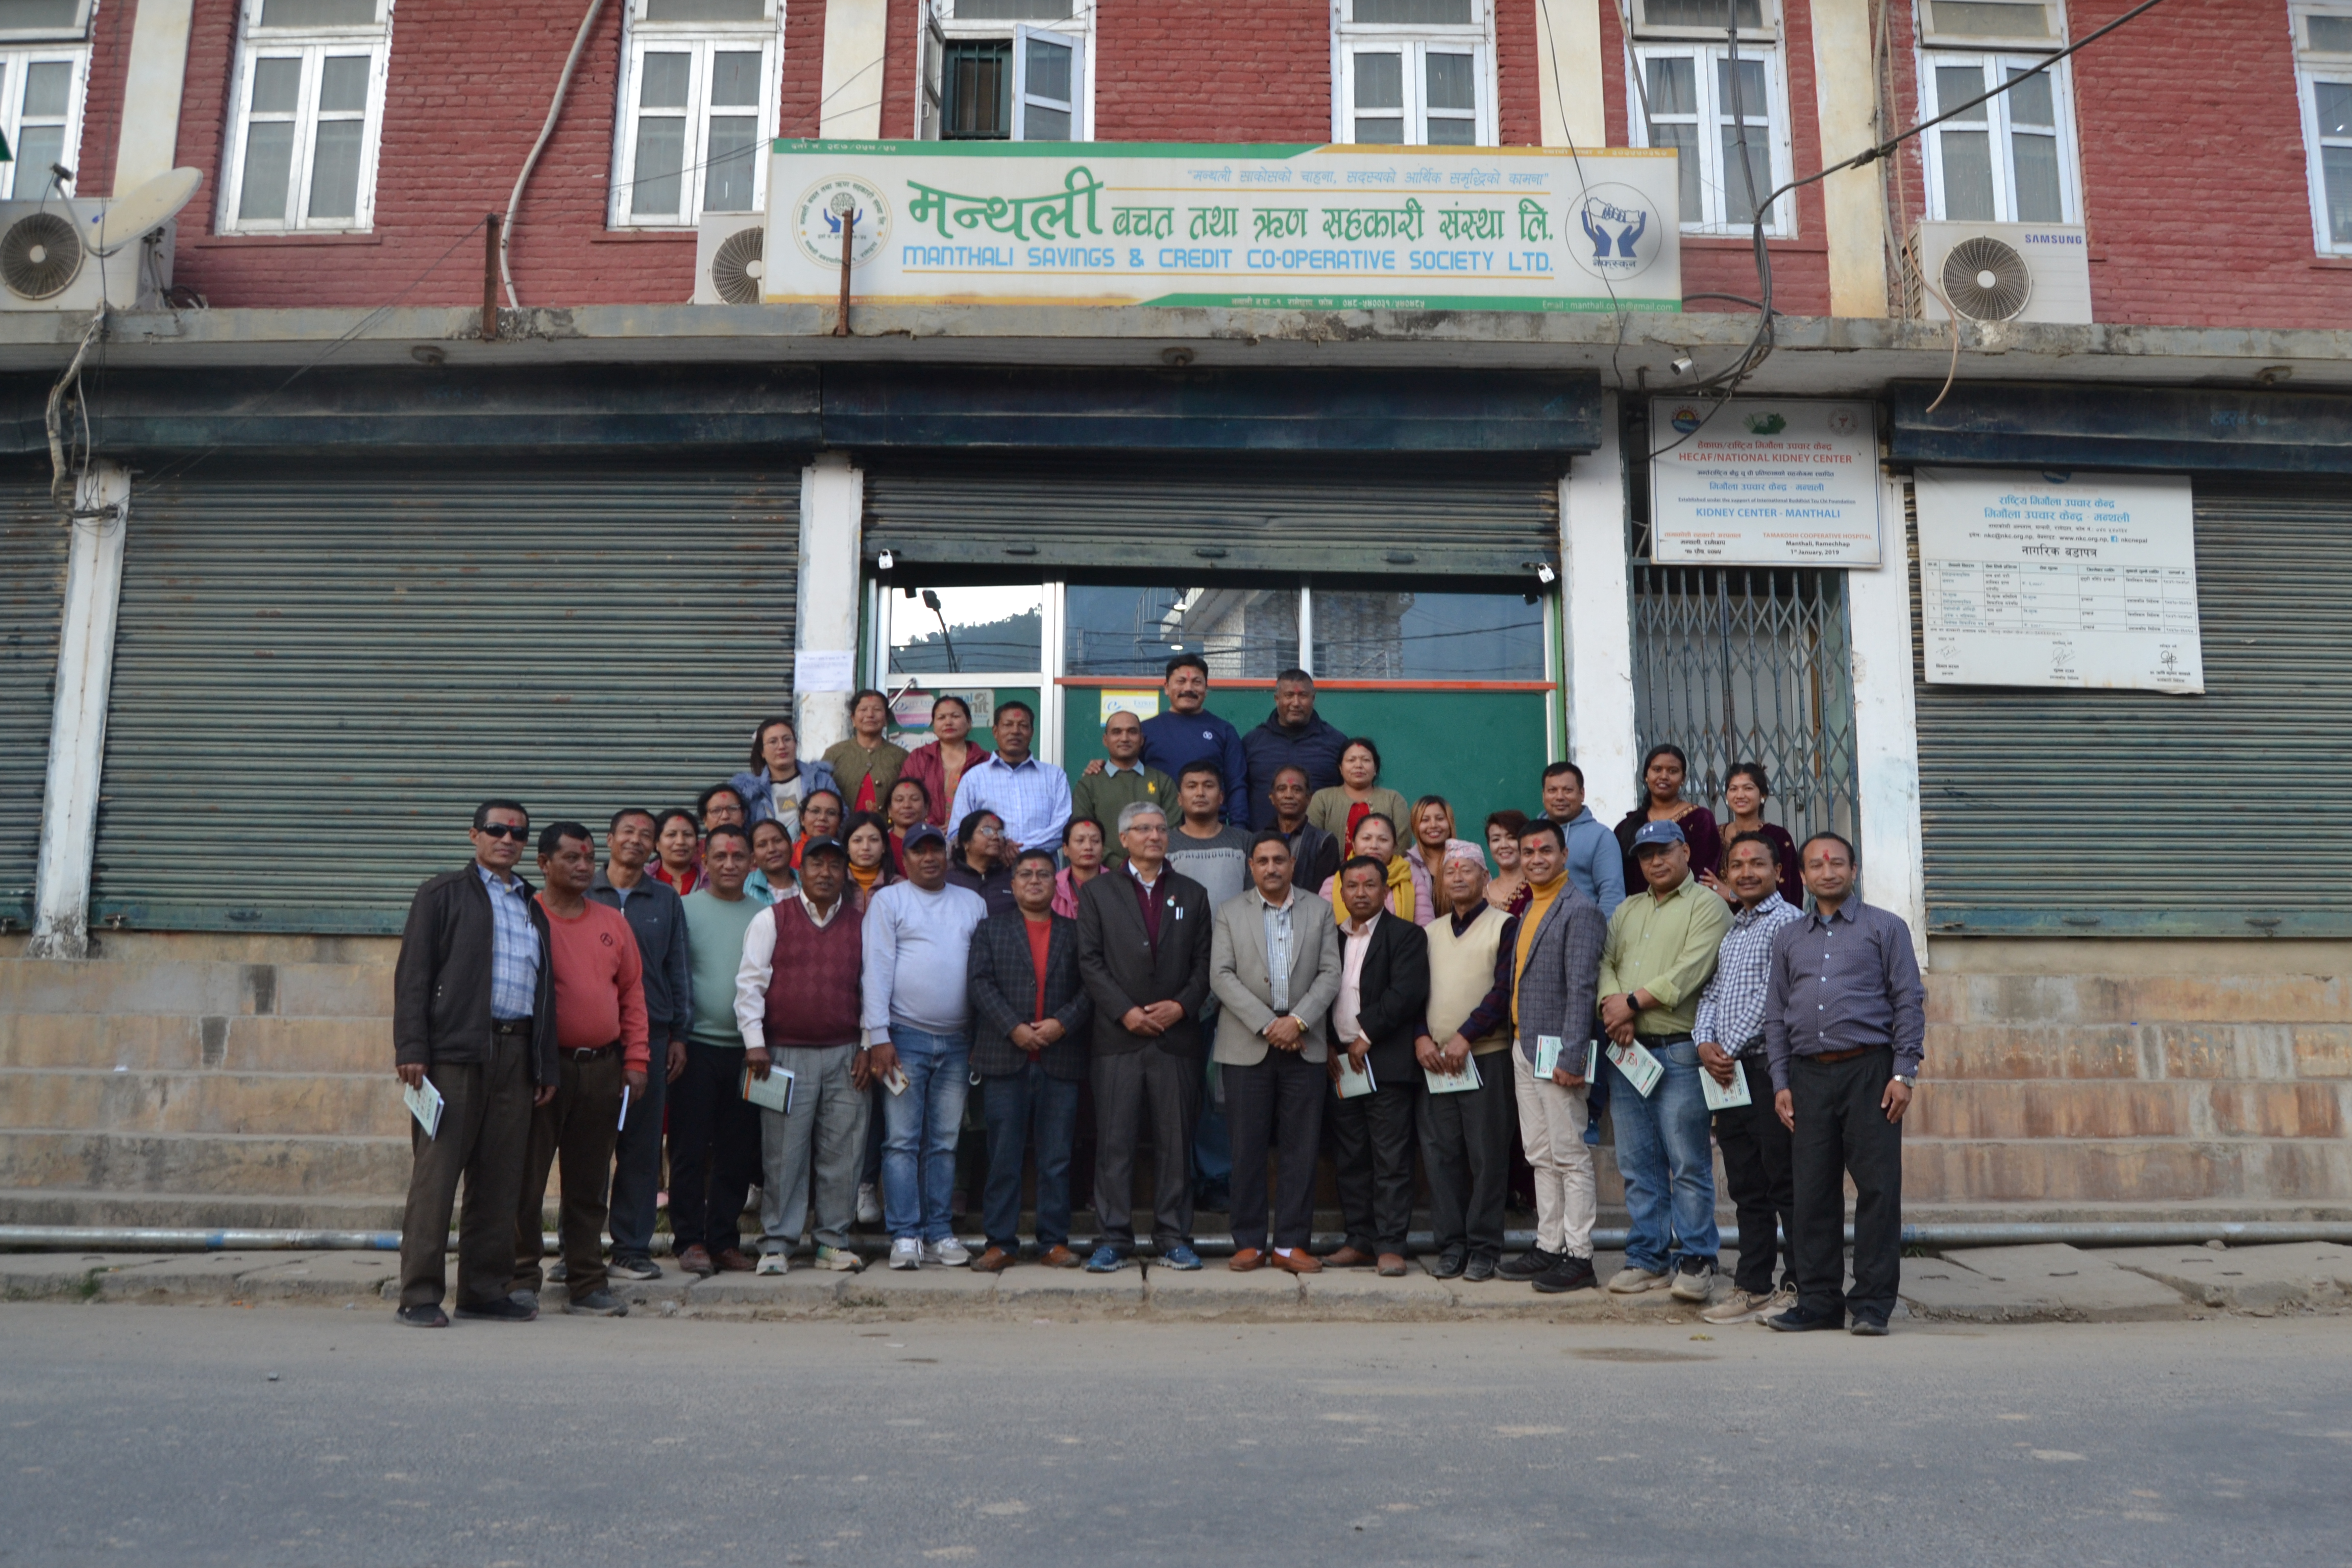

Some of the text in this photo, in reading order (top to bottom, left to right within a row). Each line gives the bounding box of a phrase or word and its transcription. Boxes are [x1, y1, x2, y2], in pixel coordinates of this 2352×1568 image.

[1405, 167, 1442, 184] आर्थिक
[908, 166, 1553, 242] मन्थली बचत तथा ऋण सहकारी संस्था लि.
[2026, 234, 2083, 244] SAMSUNG
[903, 246, 1553, 272] MANTHALI SAVINGS & CREDIT CO-OPERATIVE SOCIETY LTD.
[1542, 300, 1564, 309] Email
[1679, 452, 1852, 463] HECAF/NATIONAL KIDNEY CENTER
[1741, 483, 1765, 492] उपचार
[1796, 483, 1825, 492] मन्थली
[2065, 498, 2092, 508] उपचार
[1696, 508, 1735, 518] KIDNEY
[1737, 508, 1777, 518] CENTER
[1785, 508, 1841, 519] MANTHALI
[2024, 509, 2056, 521] उपचार
[2059, 510, 2083, 522] केन्द्र
[2094, 511, 2130, 523] मन्थली
[2059, 535, 2109, 543] www.nkc.org.np,
[2022, 544, 2060, 557] नागरिक
